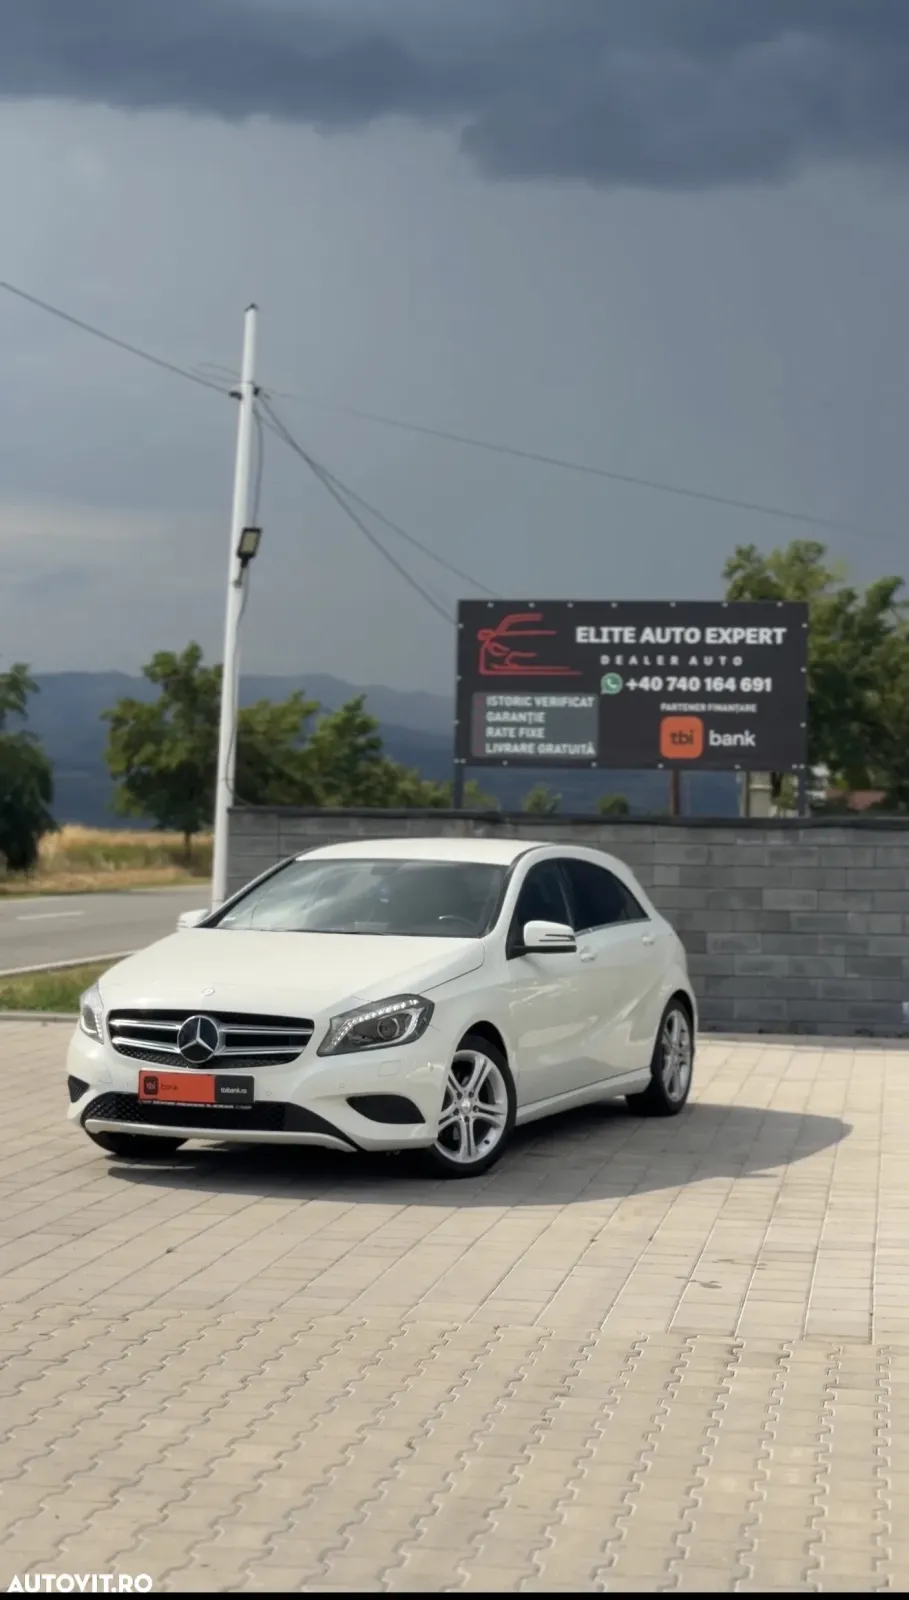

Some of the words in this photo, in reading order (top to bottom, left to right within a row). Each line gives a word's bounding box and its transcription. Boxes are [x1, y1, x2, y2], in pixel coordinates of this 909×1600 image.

[575, 626, 637, 645] ELITE
[640, 627, 702, 645] AUTO
[705, 627, 787, 645] EXPERT
[600, 655, 680, 666] DEALER
[688, 655, 744, 667] AUTO
[626, 676, 663, 692] +40
[666, 677, 701, 692] 740
[704, 677, 737, 692] 164
[740, 677, 773, 692] 691
[486, 695, 533, 707] ISTORIC
[534, 696, 595, 708] VERIFICAT
[660, 703, 707, 713] PARTENER
[485, 726, 517, 738] RATE
[518, 727, 545, 738] FIXE
[669, 730, 694, 745] tbi
[709, 730, 756, 747] bank
[485, 742, 535, 754] LIVRARE
